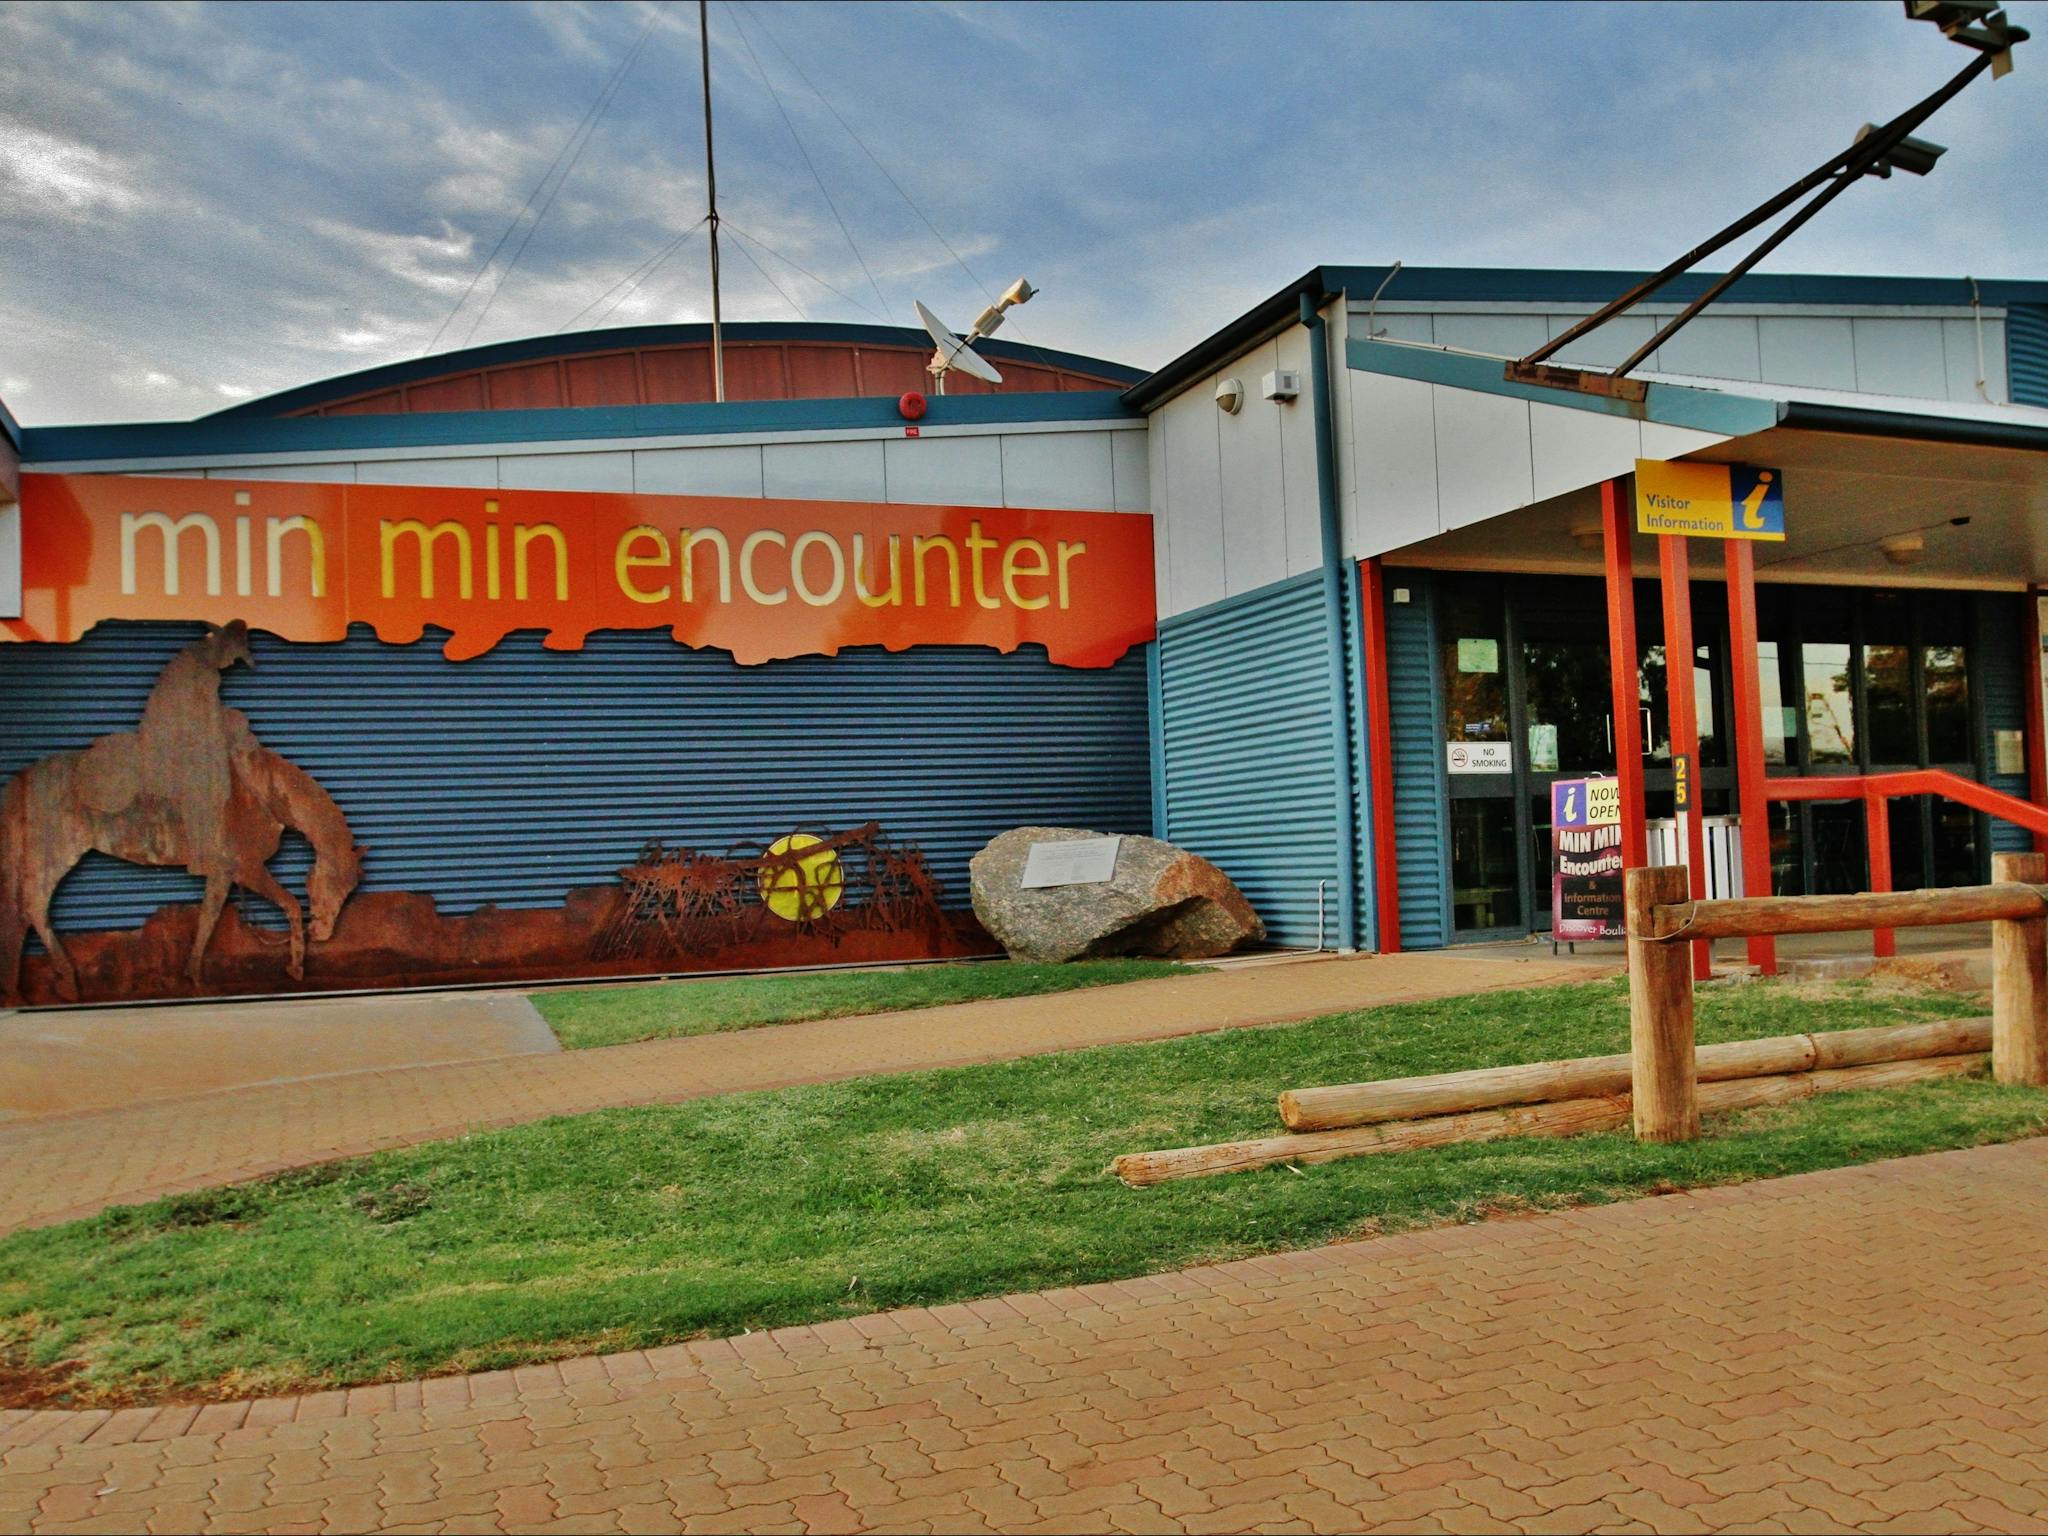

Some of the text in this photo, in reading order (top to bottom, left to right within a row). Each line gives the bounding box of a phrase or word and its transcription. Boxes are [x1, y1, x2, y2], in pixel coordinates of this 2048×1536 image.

[1646, 493, 1691, 510] Visitor
[1647, 514, 1724, 531] Information
[121, 491, 1087, 610] min min encounter
[1483, 748, 1495, 756] NO
[1472, 759, 1507, 768] SMOKING
[1590, 787, 1620, 801] NOW
[1559, 824, 1622, 853] MIN MIN
[1559, 854, 1623, 876] Encounter
[1563, 892, 1622, 903] Information
[1577, 905, 1609, 916] Centre
